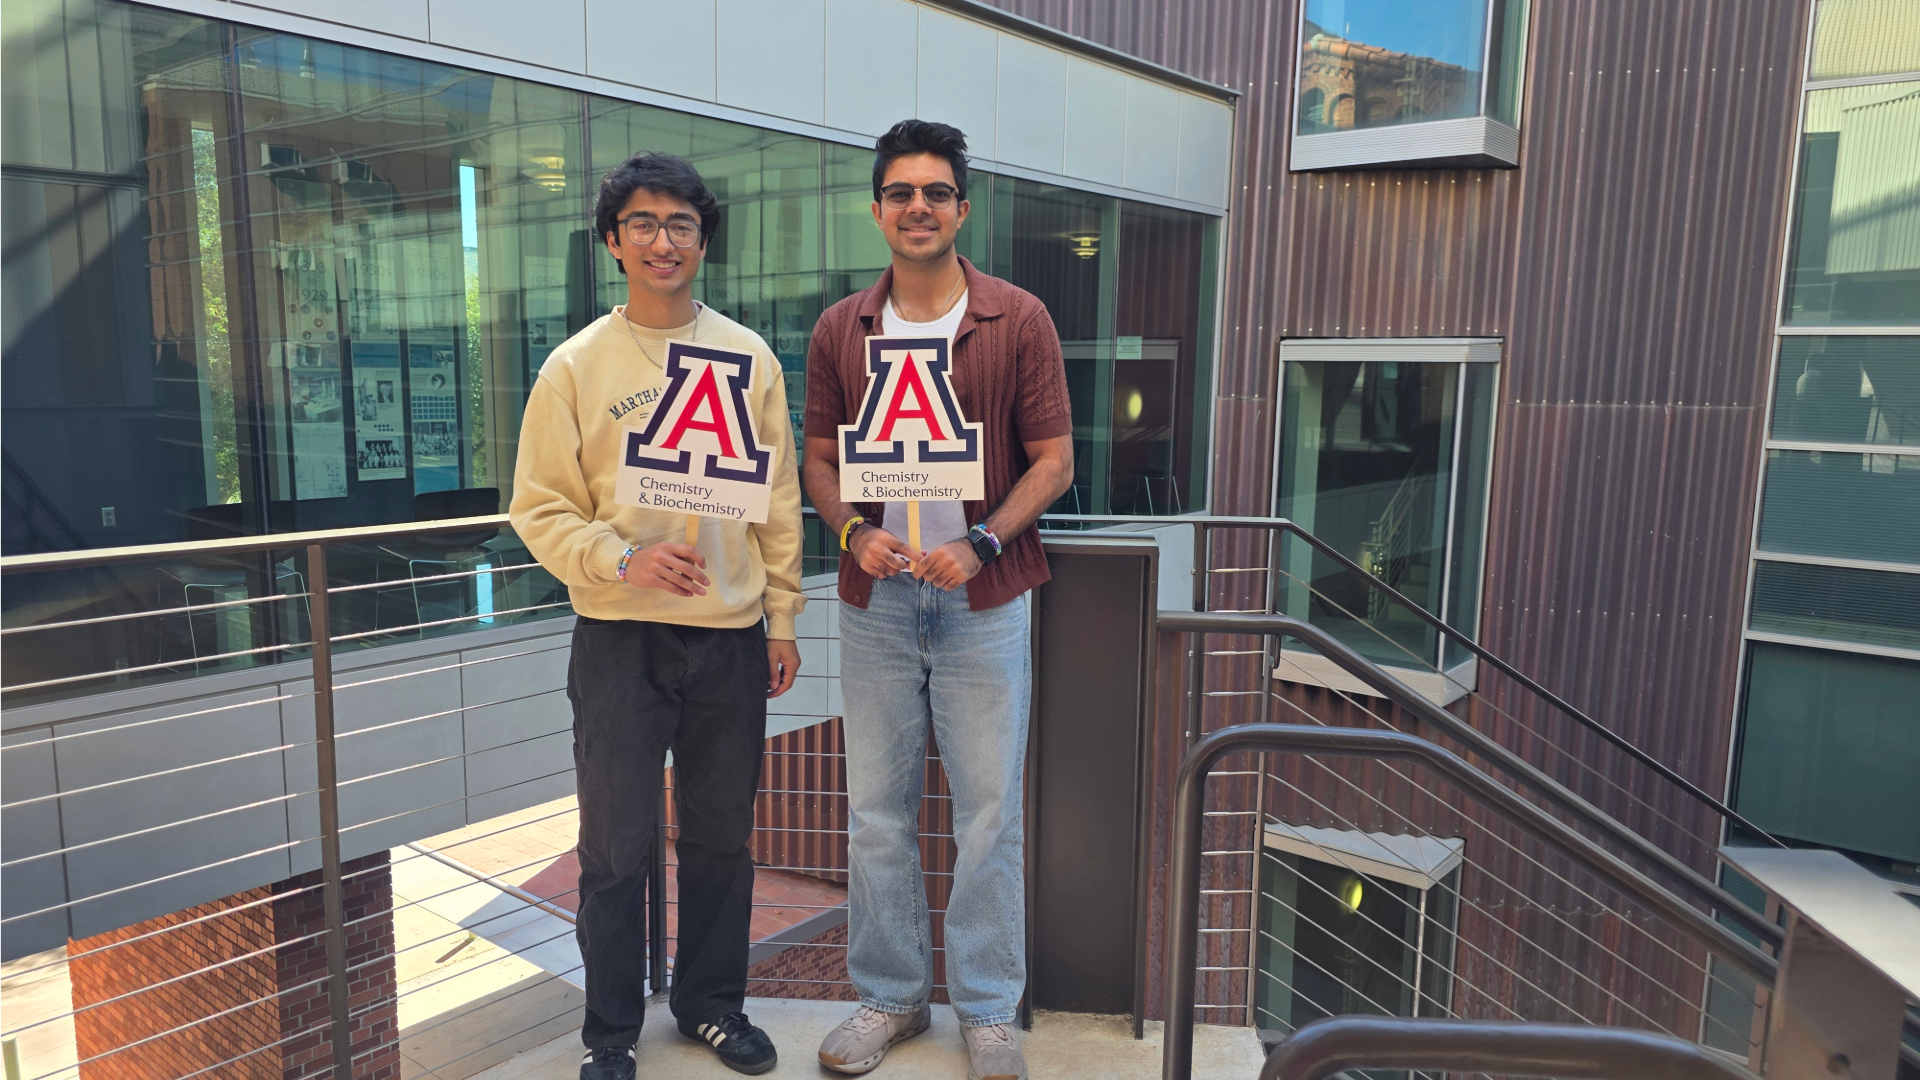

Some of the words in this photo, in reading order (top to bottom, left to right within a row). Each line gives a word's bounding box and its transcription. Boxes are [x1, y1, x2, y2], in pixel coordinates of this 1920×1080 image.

[410, 267, 448, 281] 1940s
[307, 277, 318, 286] to
[531, 275, 562, 288] 1950s
[295, 288, 329, 301] 1929
[711, 289, 736, 300] 1980s
[780, 295, 802, 307] today
[844, 337, 978, 464] A
[625, 342, 771, 485] A
[861, 471, 929, 485] Chemistry
[640, 476, 713, 500] Chemistry
[862, 486, 874, 498] &
[876, 485, 963, 500] Biochemistry
[638, 491, 651, 505] &
[653, 493, 746, 519] Biochemistry
